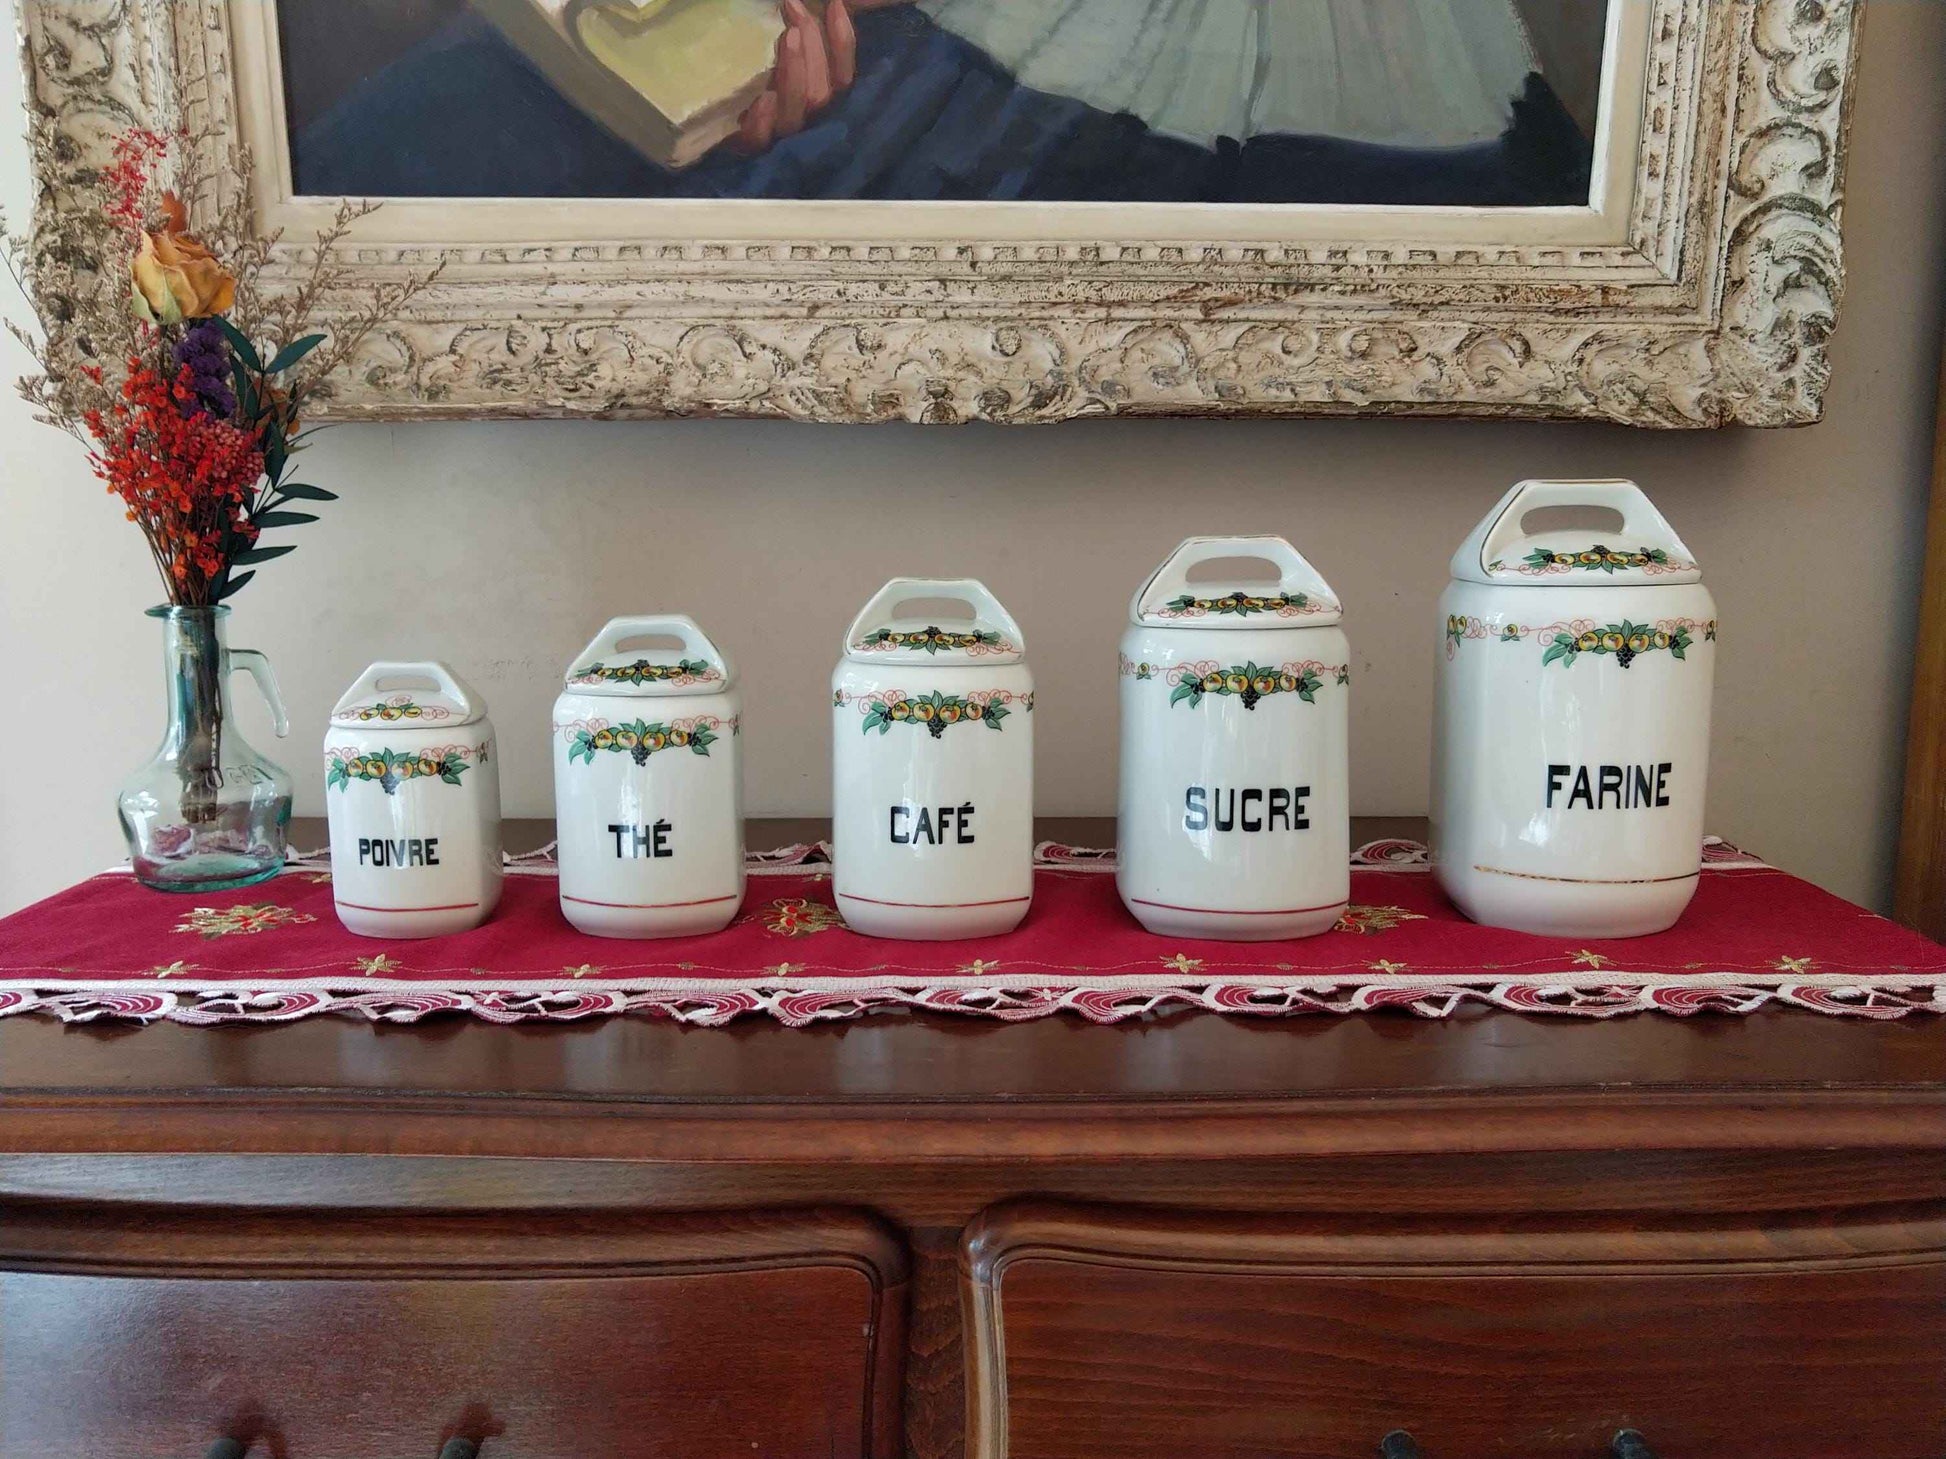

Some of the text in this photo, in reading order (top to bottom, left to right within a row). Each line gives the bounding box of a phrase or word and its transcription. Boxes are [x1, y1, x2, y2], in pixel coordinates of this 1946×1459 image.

[1546, 762, 1673, 810] FARINE
[889, 801, 975, 845] CAFÉ
[1185, 785, 1311, 833] SUCRE
[358, 837, 440, 867] POIVRE
[607, 818, 673, 859] THÉ
